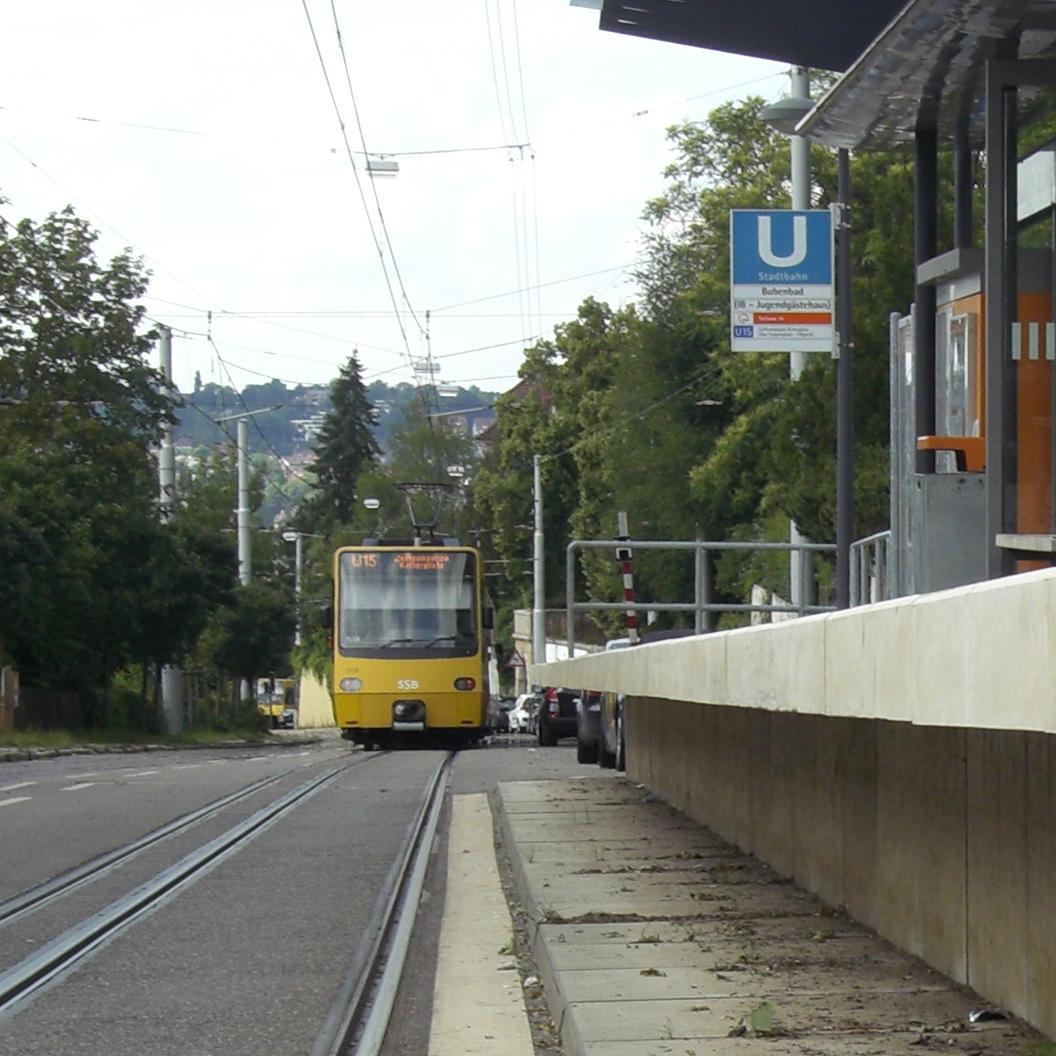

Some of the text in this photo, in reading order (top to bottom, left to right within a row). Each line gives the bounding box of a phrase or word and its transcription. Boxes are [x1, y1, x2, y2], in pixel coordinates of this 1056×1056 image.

[757, 215, 808, 268] U
[757, 272, 809, 281] Stadtbahn
[761, 287, 804, 296] Bubenbad
[734, 328, 752, 337] U15
[351, 554, 377, 568] U15
[397, 679, 419, 690] SSB
